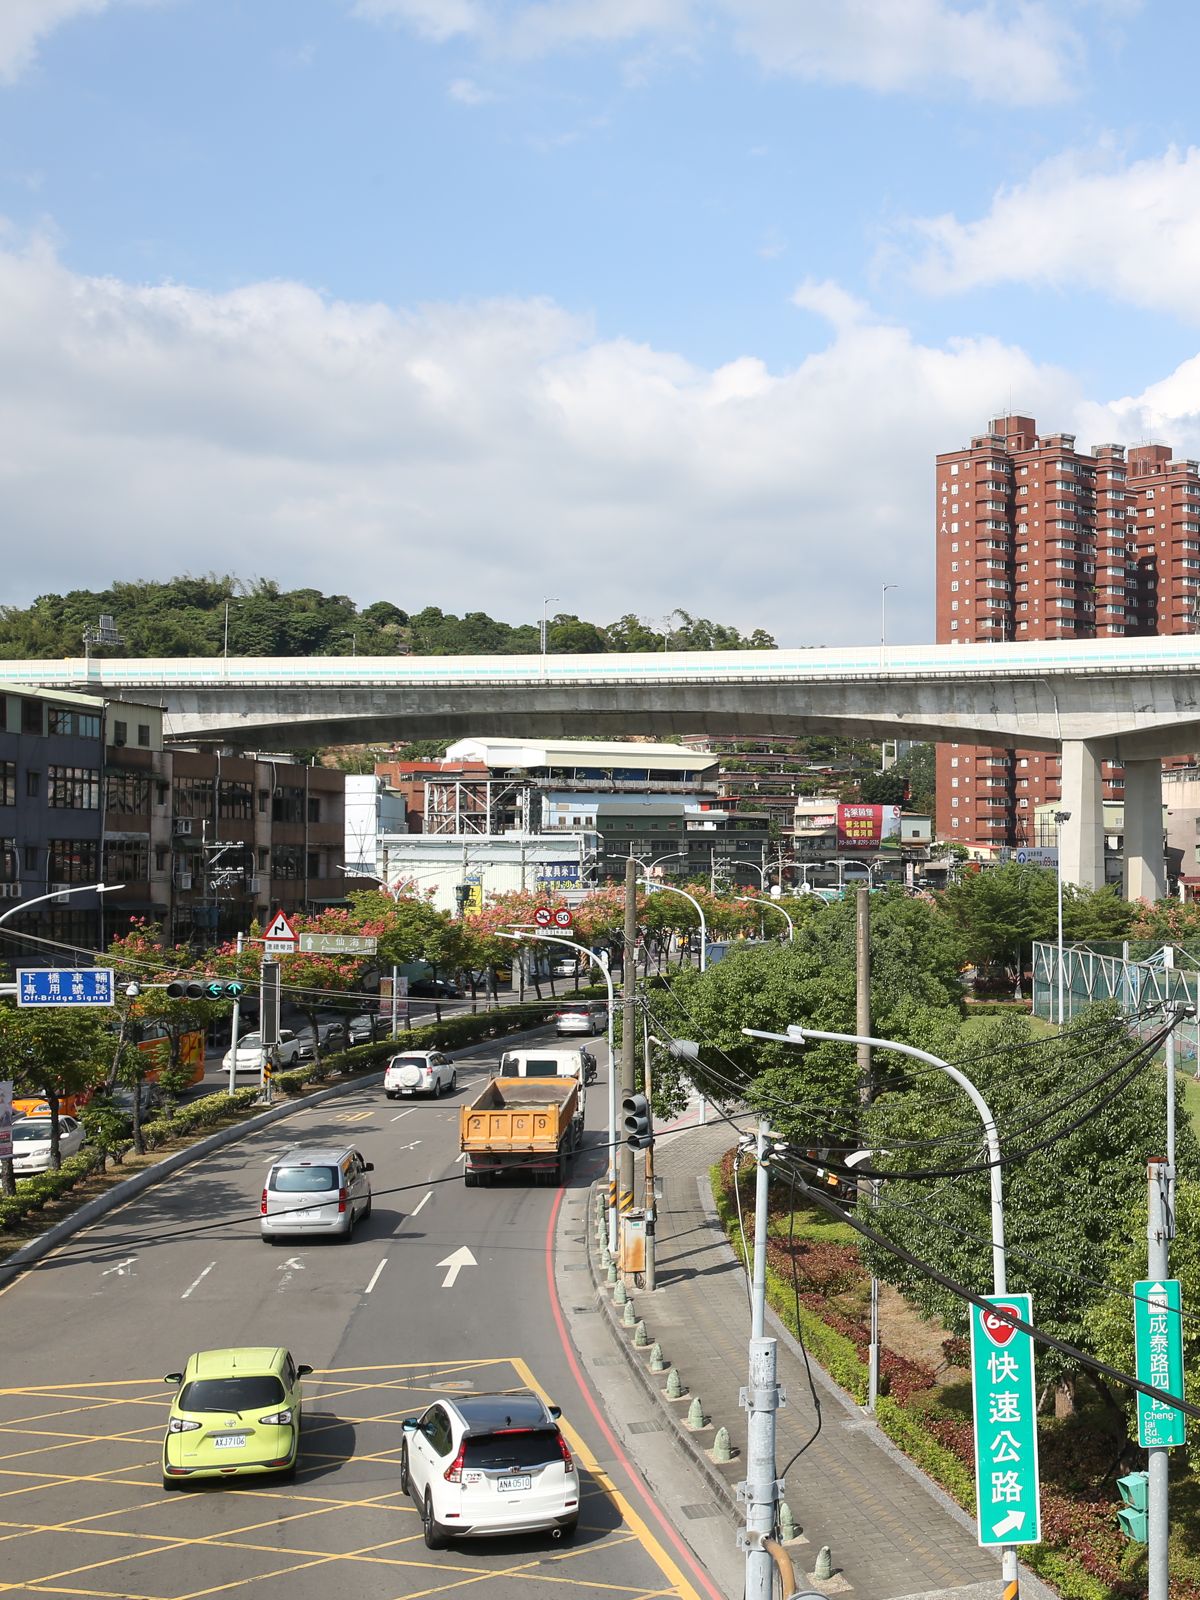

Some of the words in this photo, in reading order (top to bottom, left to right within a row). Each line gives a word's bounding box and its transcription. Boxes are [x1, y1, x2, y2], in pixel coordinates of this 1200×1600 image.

[557, 914, 569, 922] 50
[320, 936, 375, 948] 八仙海岸
[23, 972, 108, 984] 下橋車輛
[23, 984, 108, 995] 專用號誌
[23, 994, 73, 1002] Off-Bridge
[76, 994, 108, 1002] Signal
[1144, 1411, 1177, 1421] Cheng-
[986, 1350, 1024, 1504] 快速公路
[1144, 1420, 1156, 1428] tai
[1144, 1427, 1160, 1437] Rd.
[1144, 1436, 1165, 1445] Sec.
[1167, 1435, 1174, 1443] 4
